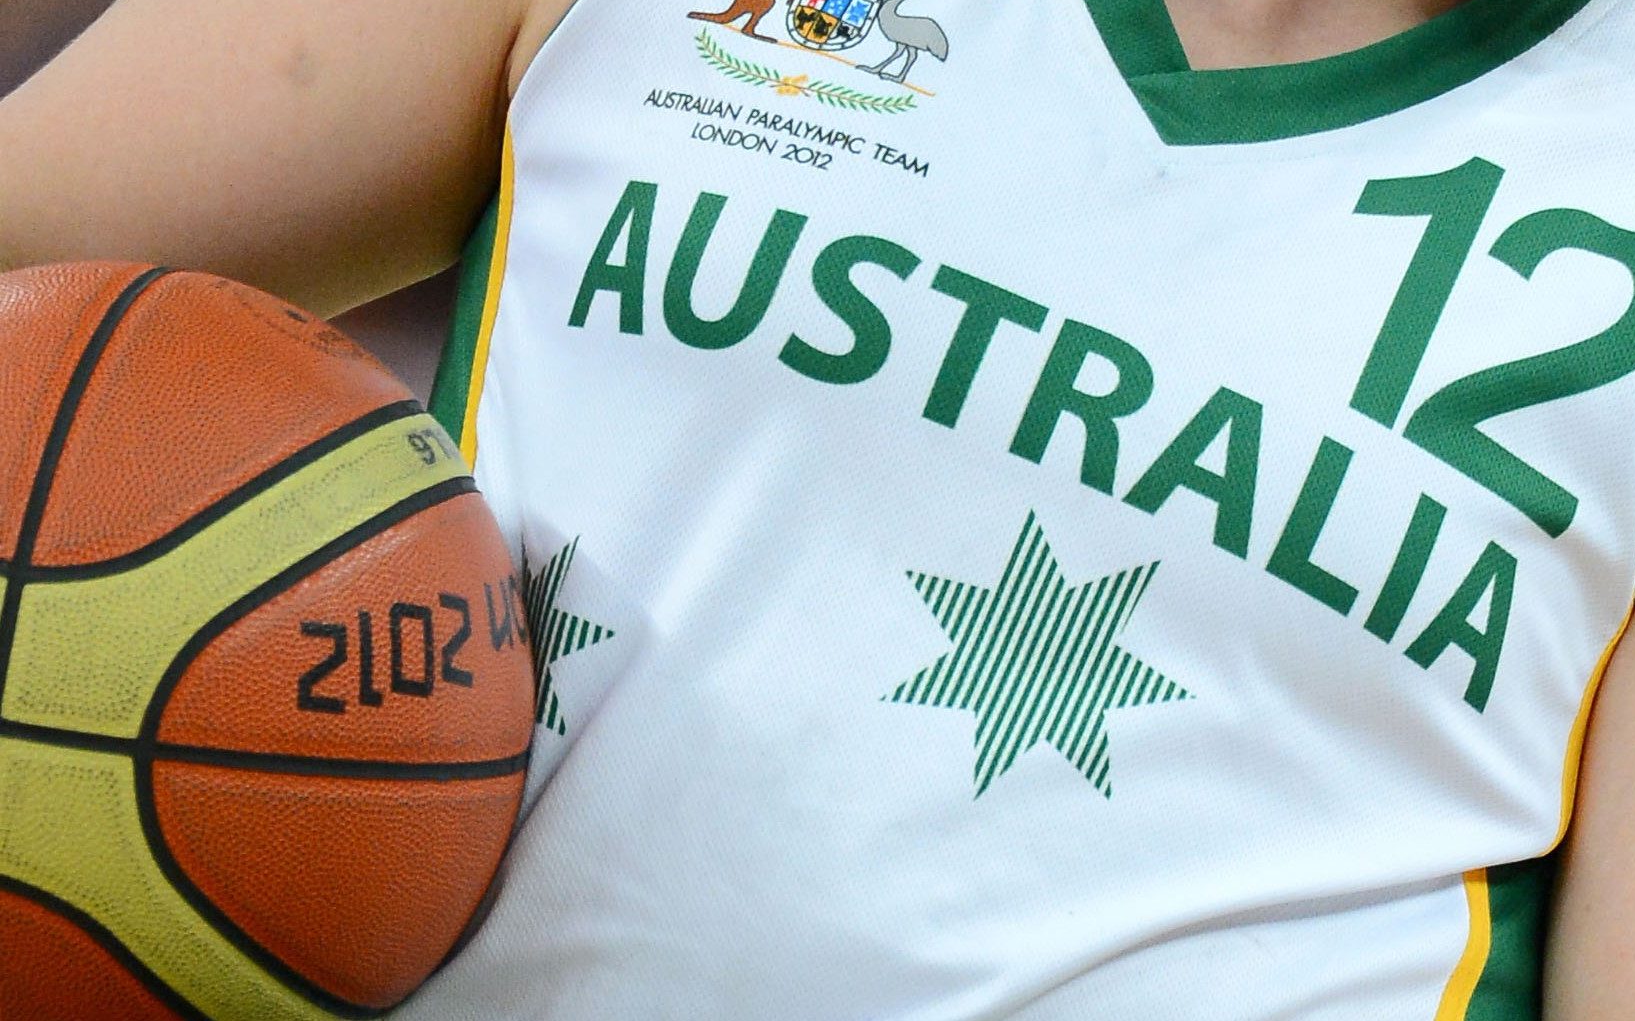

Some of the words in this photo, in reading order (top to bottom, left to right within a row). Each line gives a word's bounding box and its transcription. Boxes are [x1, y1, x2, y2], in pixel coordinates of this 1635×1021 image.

[644, 89, 743, 120] AUSTRALIAN
[746, 108, 866, 154] PARALYMPIC
[873, 143, 930, 177] TEAM
[691, 123, 777, 154] LONDON
[781, 144, 832, 170] 2012
[568, 180, 1518, 713] AUSTRALIA
[297, 592, 474, 714] 2012
